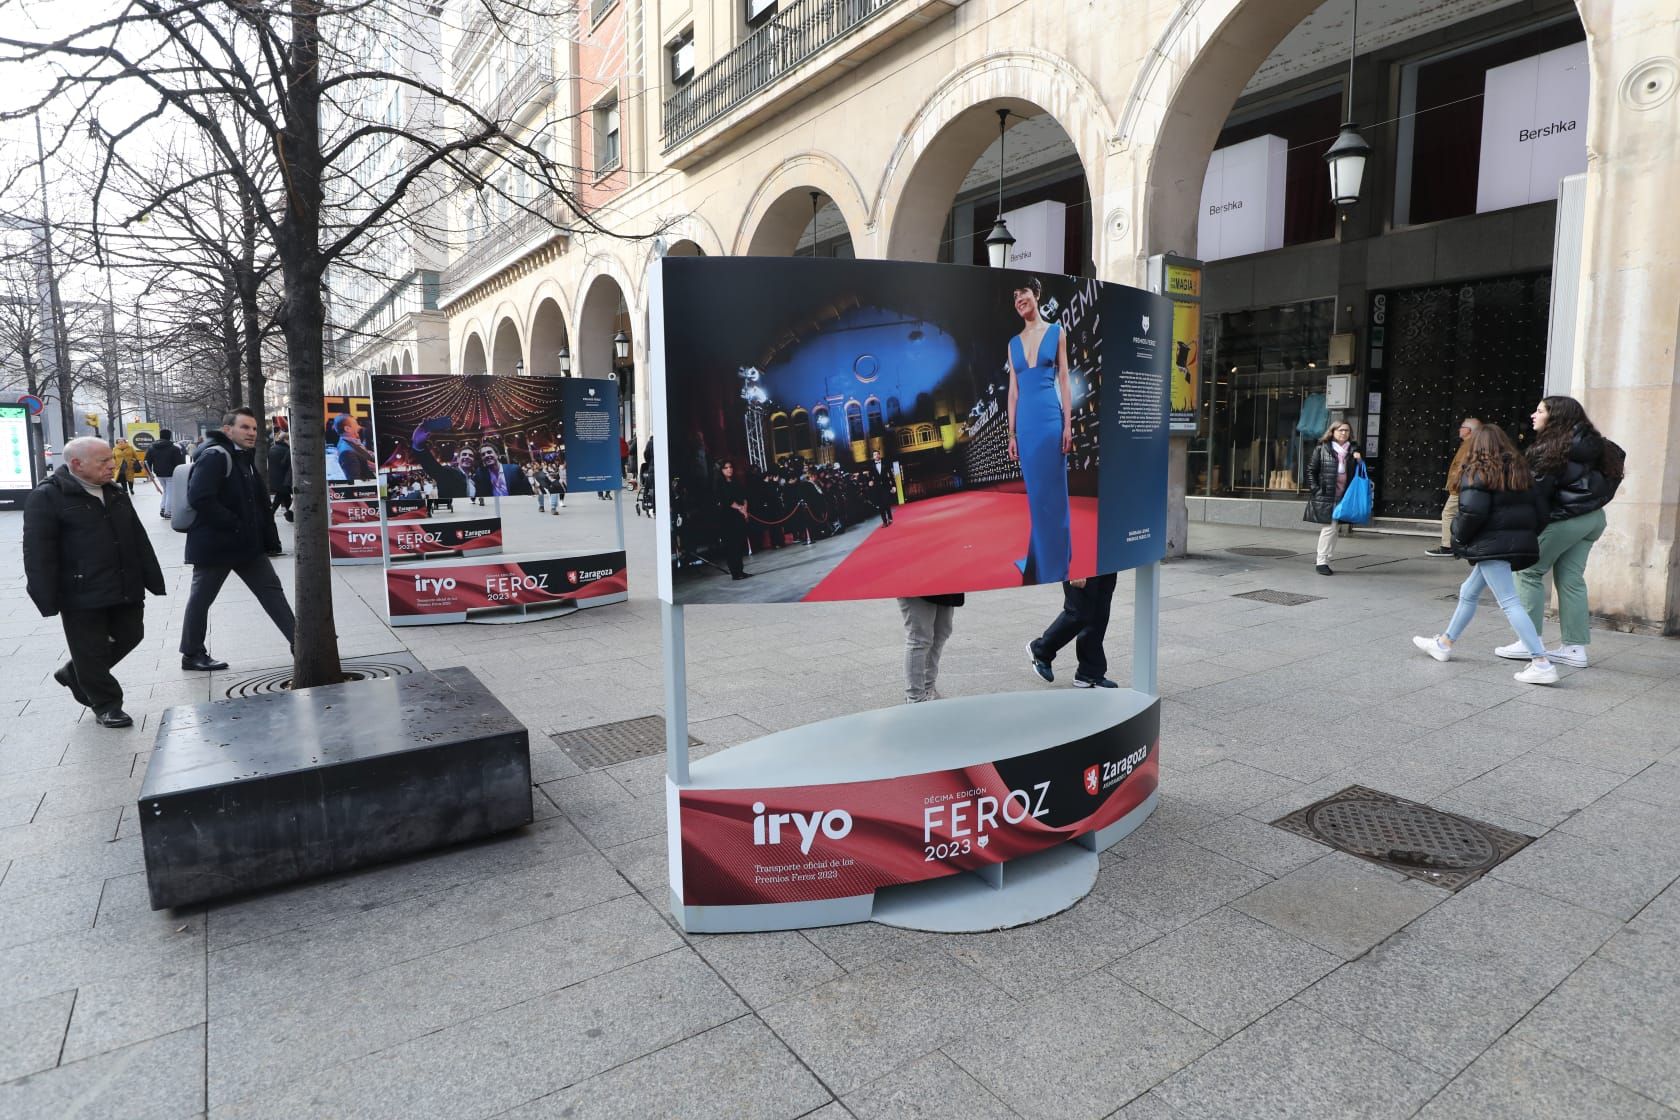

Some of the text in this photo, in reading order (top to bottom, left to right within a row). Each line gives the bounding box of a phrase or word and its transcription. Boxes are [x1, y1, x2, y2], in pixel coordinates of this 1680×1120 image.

[1519, 120, 1576, 142] Bershka
[1209, 200, 1243, 216] Bershka
[1010, 251, 1032, 263] Bershka
[348, 530, 377, 546] iryo
[397, 531, 442, 545] FEROZ
[464, 529, 491, 538] Zaragoza
[579, 568, 613, 580] Zaragoza
[415, 574, 457, 596] iryo
[486, 573, 549, 594] FEROZ
[487, 592, 510, 601] 2023
[1102, 744, 1147, 782] Zaragoza
[924, 787, 987, 805] DÉCIMA EDICIÓN
[924, 780, 1051, 843] FEROZ
[752, 801, 853, 856] iryo
[924, 839, 971, 862] 2023
[755, 858, 855, 873] Transporte oficial de los
[755, 870, 838, 884] Premios Feroz 2023
